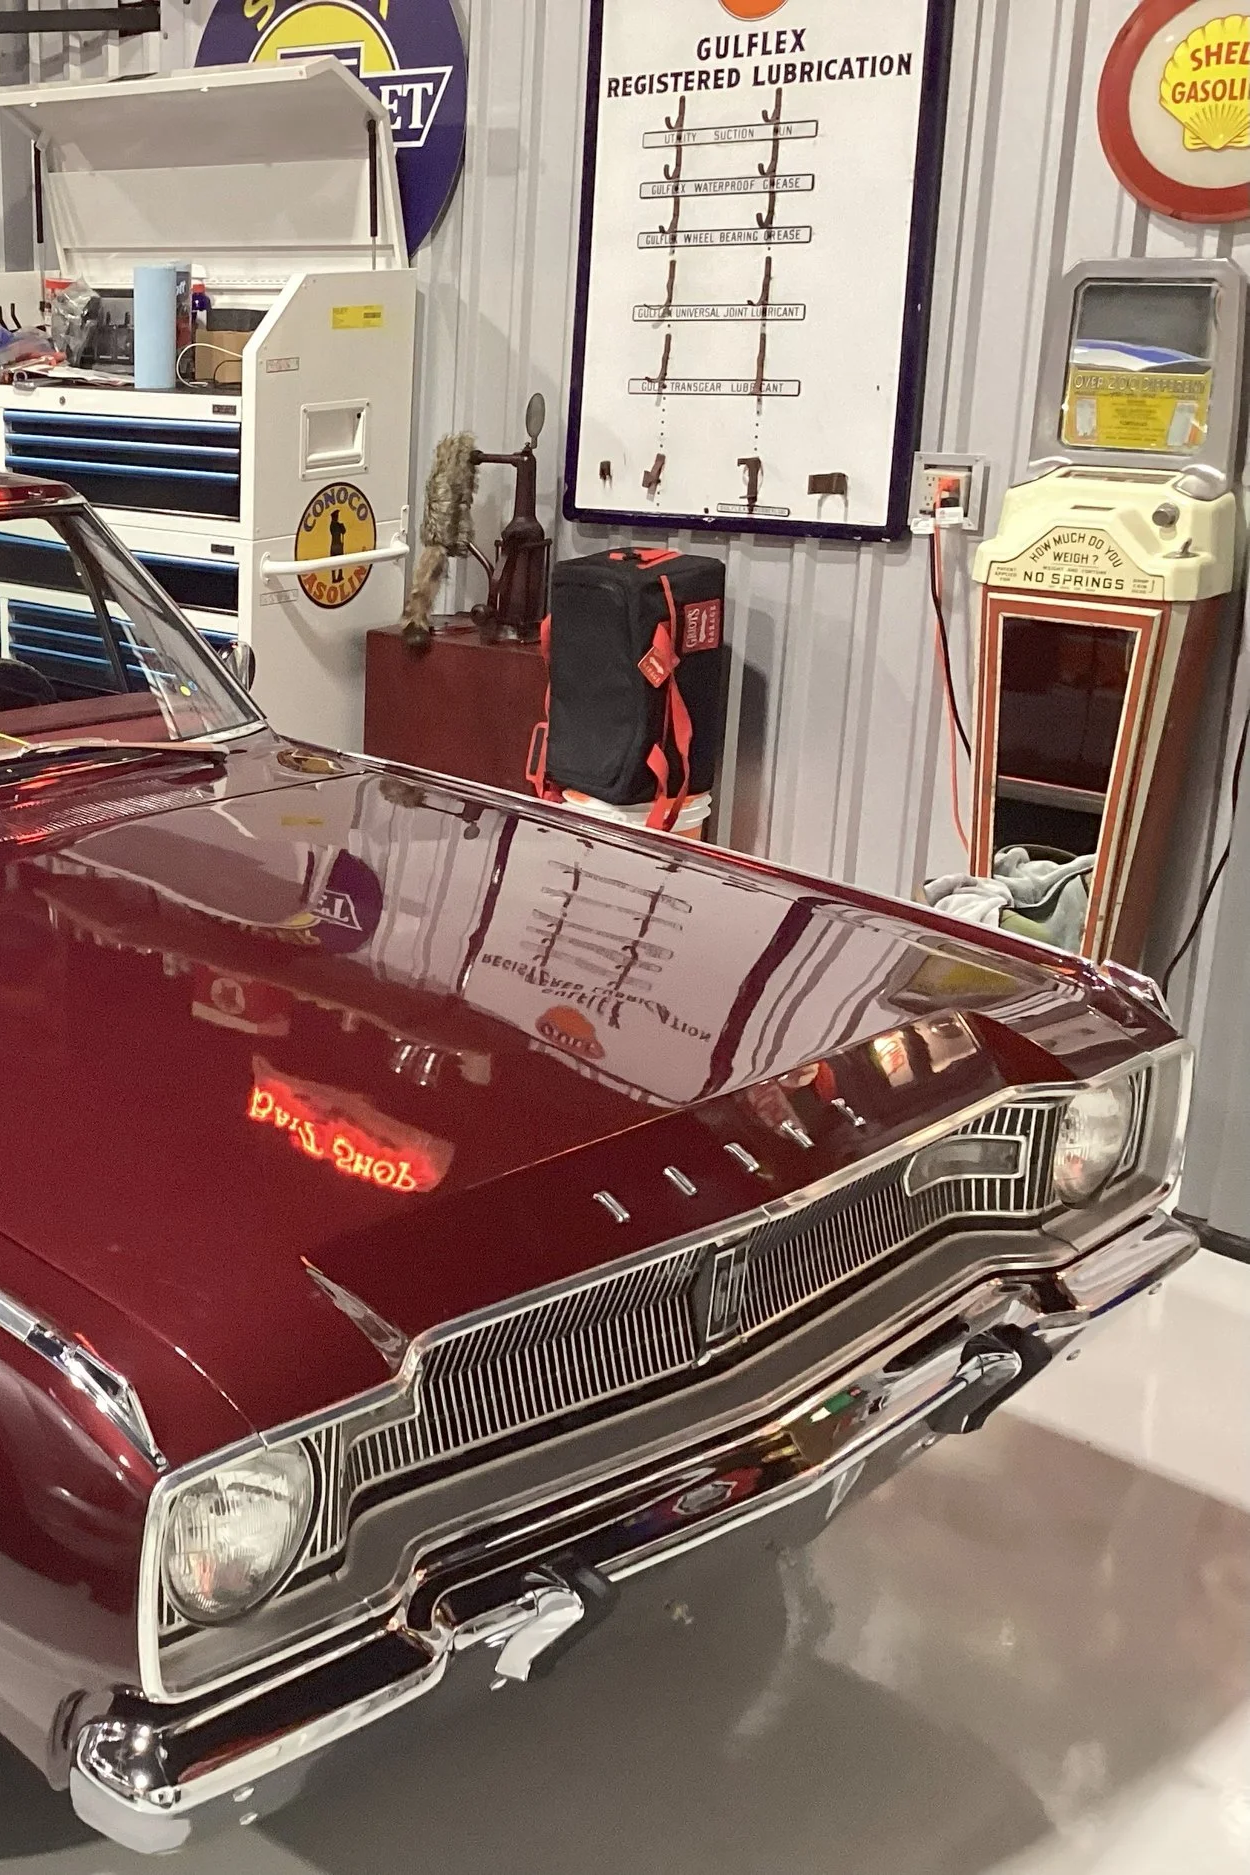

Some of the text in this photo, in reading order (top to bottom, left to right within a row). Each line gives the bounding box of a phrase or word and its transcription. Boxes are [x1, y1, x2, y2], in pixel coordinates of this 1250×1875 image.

[696, 28, 807, 61] GULFLEX
[1190, 41, 1250, 72] SHEL
[607, 53, 913, 98] REGISTERED LUBRICATION
[1171, 78, 1250, 104] GASOLI
[664, 132, 697, 144] UTITY
[714, 128, 755, 141] SUCTION
[694, 179, 755, 193] WATERPROOF
[683, 232, 714, 244] WHEEL
[719, 230, 759, 243] BEARING
[675, 307, 720, 319] UNIVERSAL
[723, 307, 749, 318] JOINT
[751, 306, 800, 318] LURICANT
[641, 380, 784, 393] GUL TRANSGEAR LUBRCANT
[303, 486, 369, 533] CONOCO
[1029, 532, 1124, 568] HOW MUCH DO YOU
[1053, 551, 1089, 564] WEIGH
[302, 564, 368, 604] ASOLIN
[1023, 571, 1045, 583] NO
[1050, 573, 1125, 590] SPRINGS
